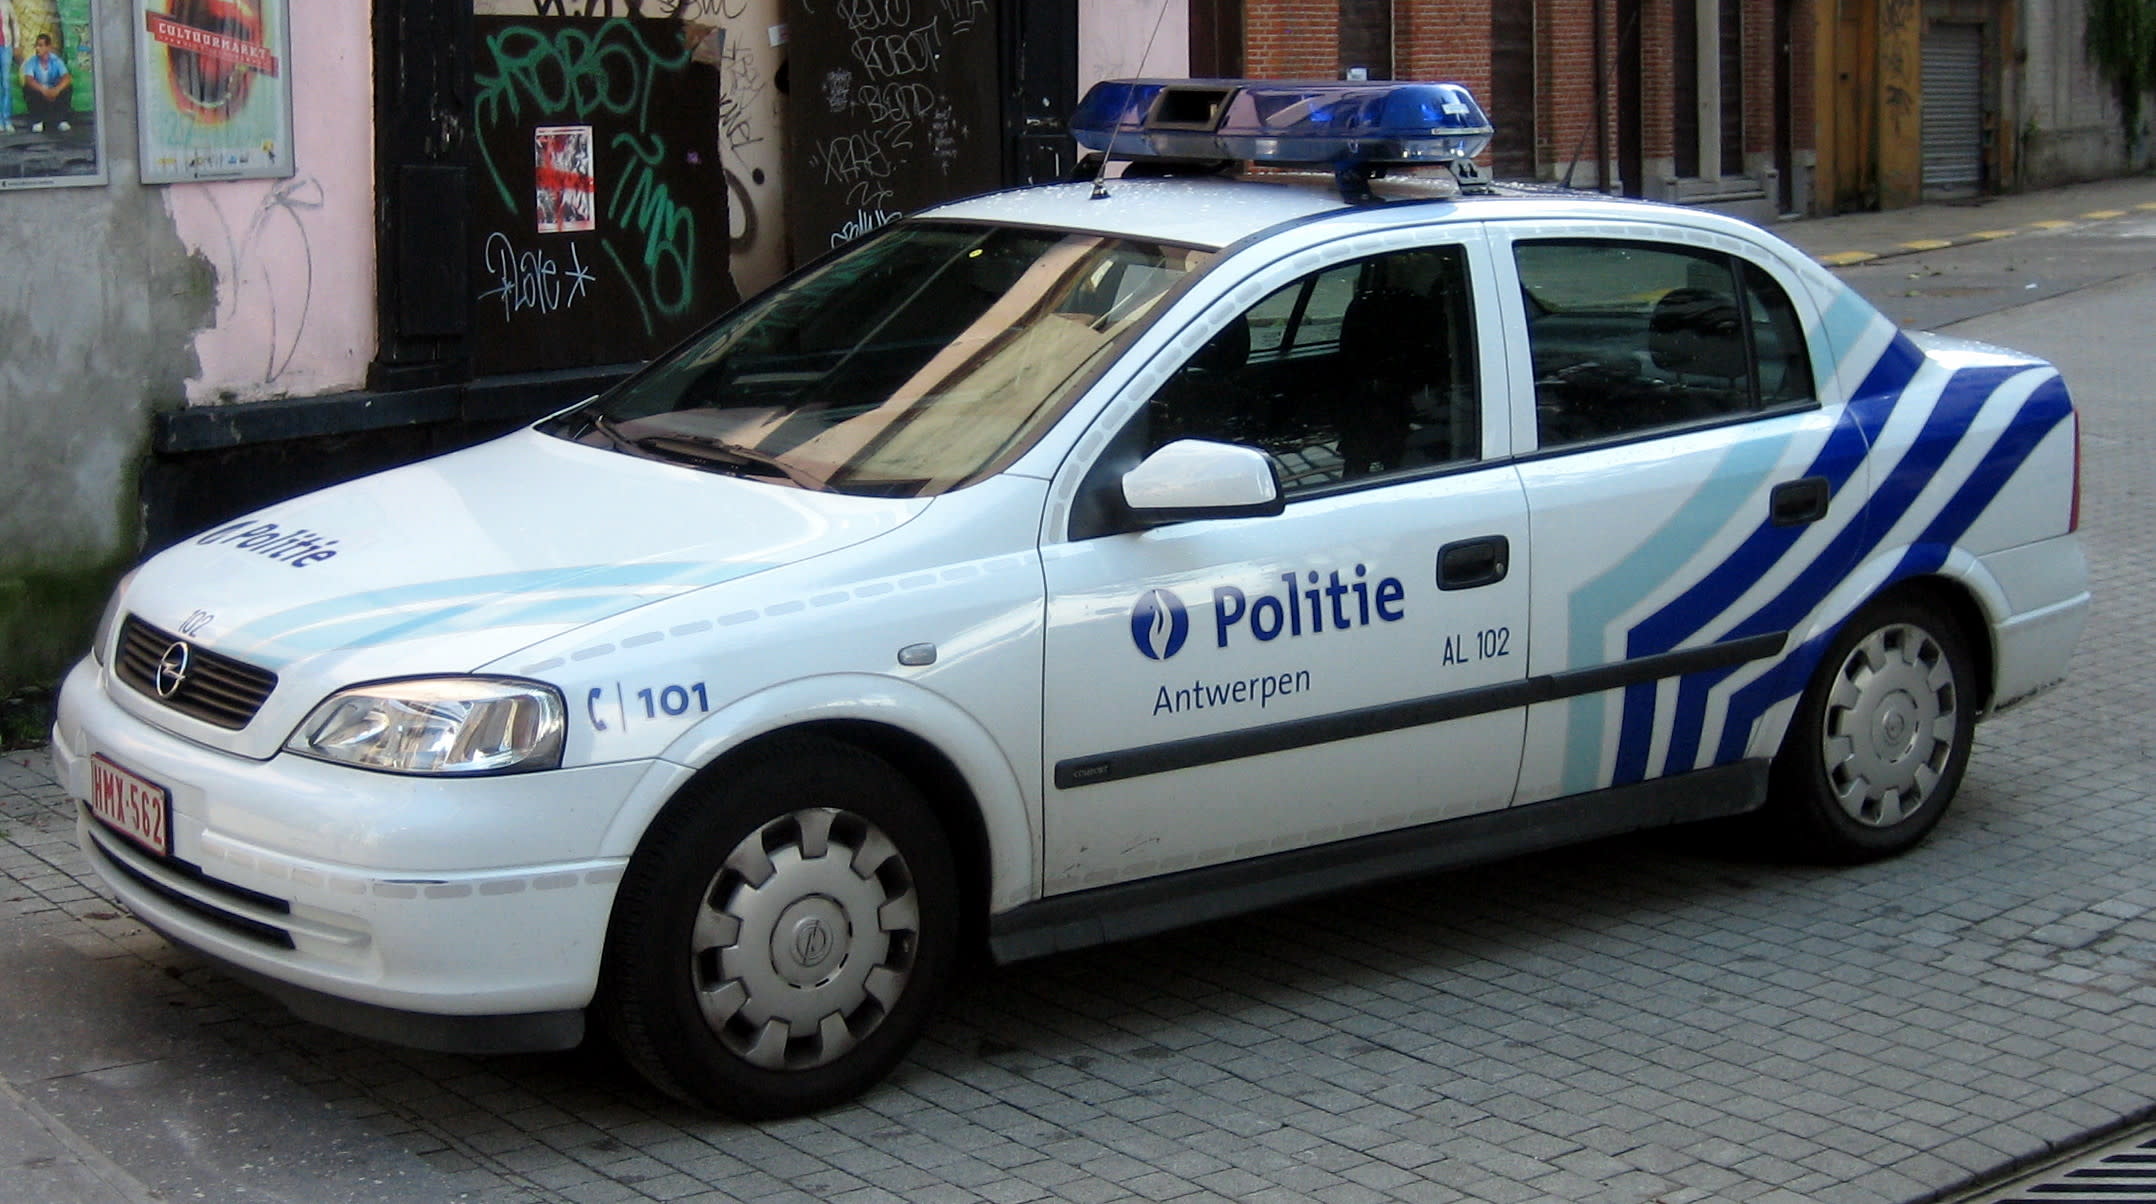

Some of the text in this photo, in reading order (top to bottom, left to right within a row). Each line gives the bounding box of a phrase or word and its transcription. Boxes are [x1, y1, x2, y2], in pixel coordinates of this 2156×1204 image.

[159, 22, 266, 58] CULTUURMARKT
[219, 523, 339, 567] Politie
[178, 609, 214, 637] 102
[1214, 564, 1405, 648] Politie
[1443, 627, 1510, 666] AL 102
[638, 682, 709, 718] 101
[1153, 670, 1310, 716] Antwerpen
